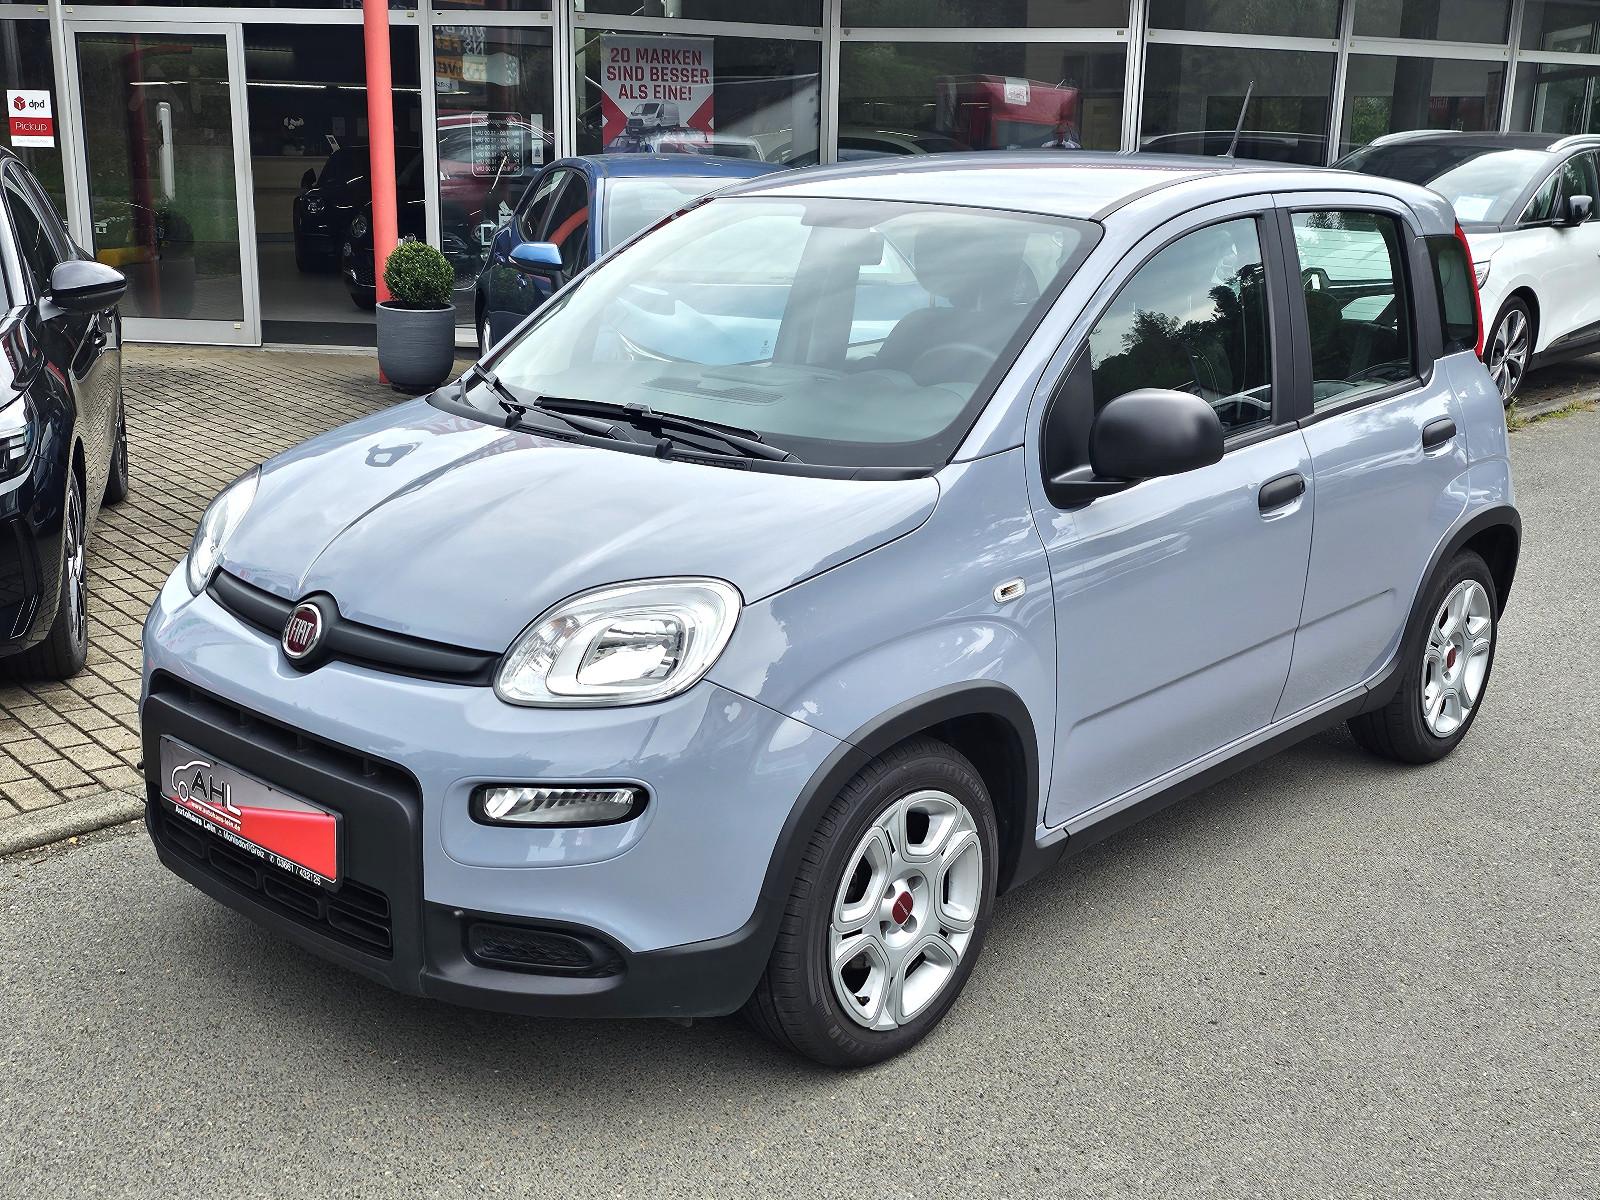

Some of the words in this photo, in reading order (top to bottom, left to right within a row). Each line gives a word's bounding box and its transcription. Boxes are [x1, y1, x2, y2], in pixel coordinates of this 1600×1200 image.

[610, 47, 631, 63] 20
[635, 47, 702, 66] MARKEN
[606, 65, 645, 81] SIND
[649, 66, 710, 84] BESSER
[618, 83, 649, 99] ALS
[653, 84, 692, 101] EINE!
[28, 99, 45, 110] dpd
[15, 121, 48, 132] Pickup
[288, 618, 314, 645] FIAT
[190, 768, 242, 816] AHL
[175, 804, 203, 826] Autohaus
[203, 819, 217, 834] Lein
